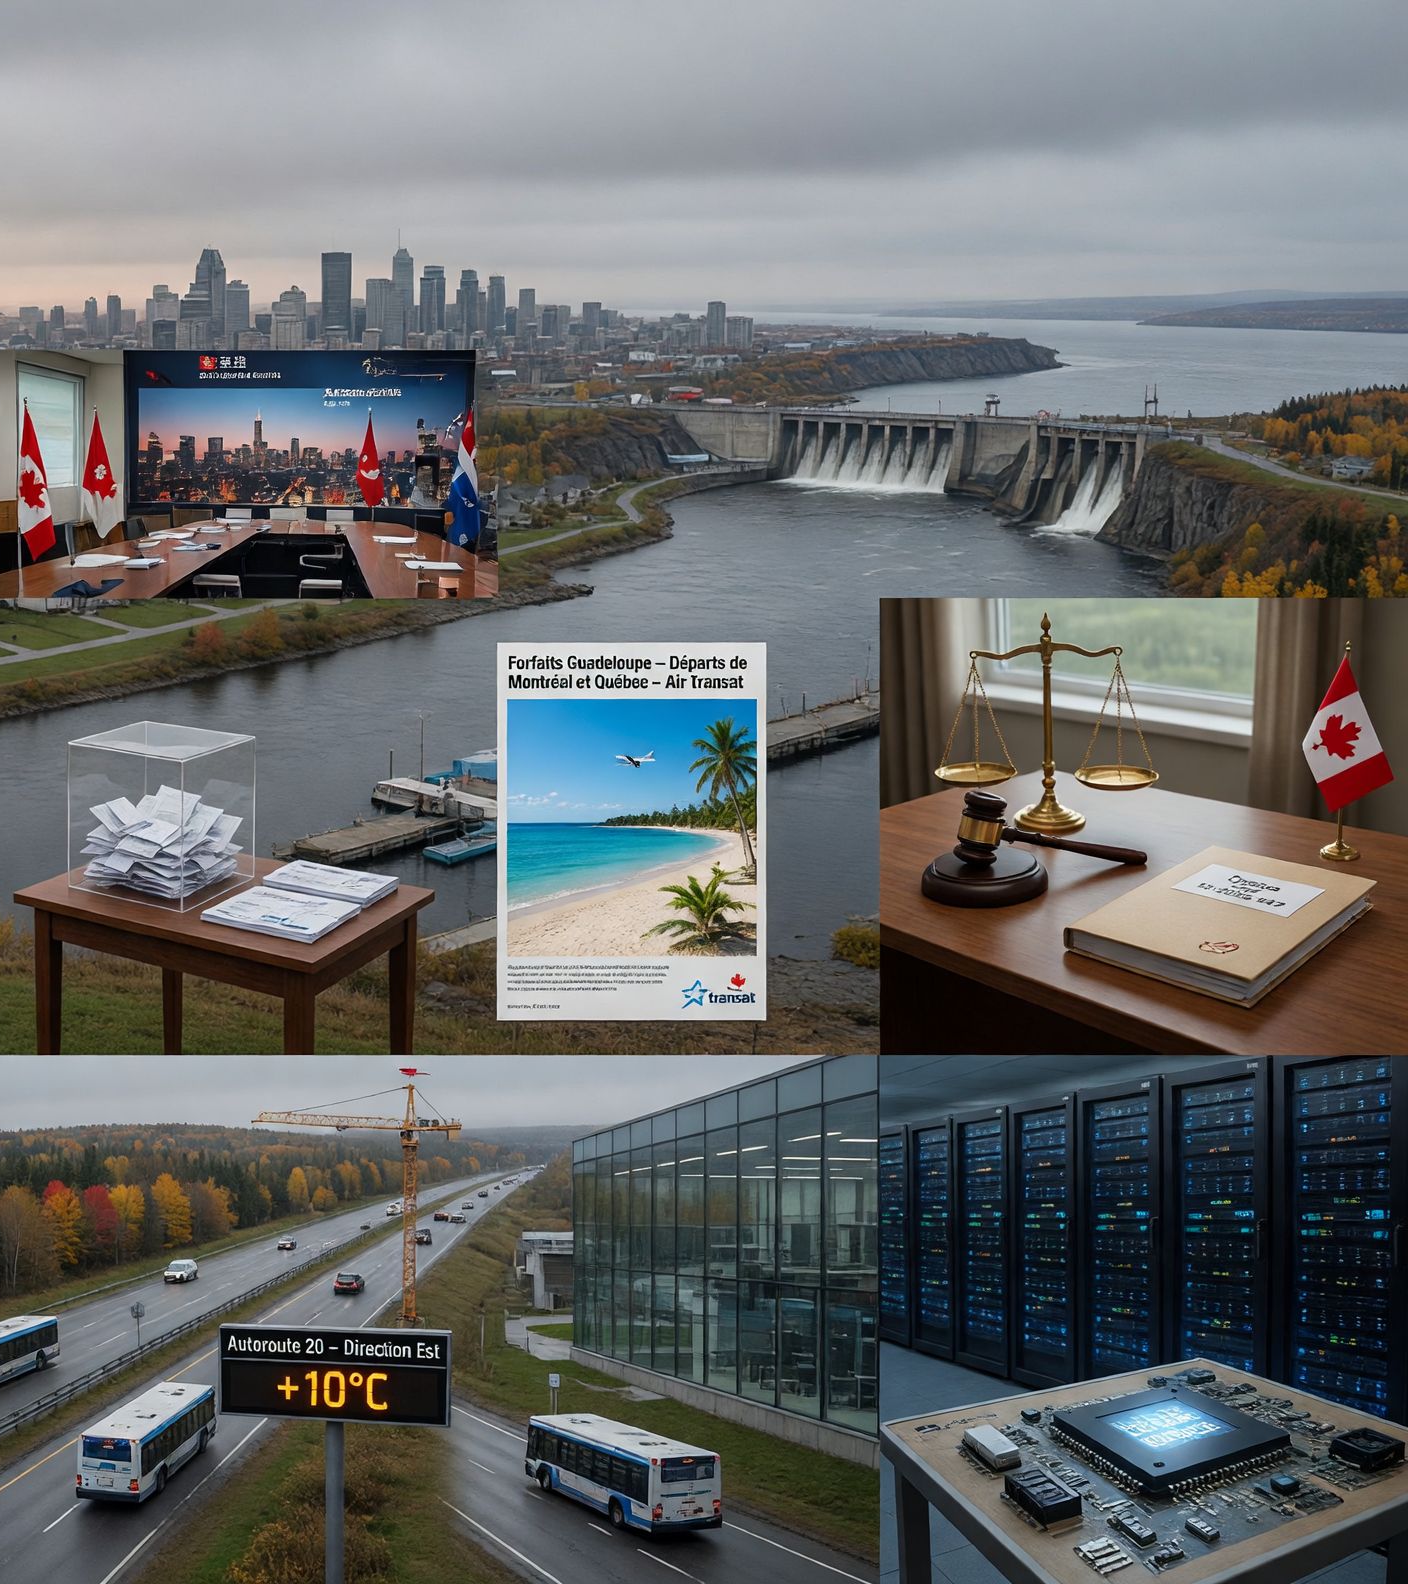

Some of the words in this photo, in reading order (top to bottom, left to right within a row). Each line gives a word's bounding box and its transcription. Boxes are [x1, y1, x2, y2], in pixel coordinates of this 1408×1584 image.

[507, 655, 564, 671] Forfaits
[567, 655, 652, 673] Guadeloupe
[669, 654, 726, 673] Départs
[729, 655, 748, 670] de
[508, 674, 573, 690] Montréal
[575, 675, 592, 690] et
[665, 674, 688, 690] Air
[690, 674, 745, 690] Transat
[708, 992, 756, 1004] transat
[227, 1335, 301, 1354] Autoroute
[305, 1337, 324, 1355] 20
[344, 1339, 412, 1359] Direction
[416, 1342, 441, 1359] Est
[277, 1370, 389, 1411] +10°C
